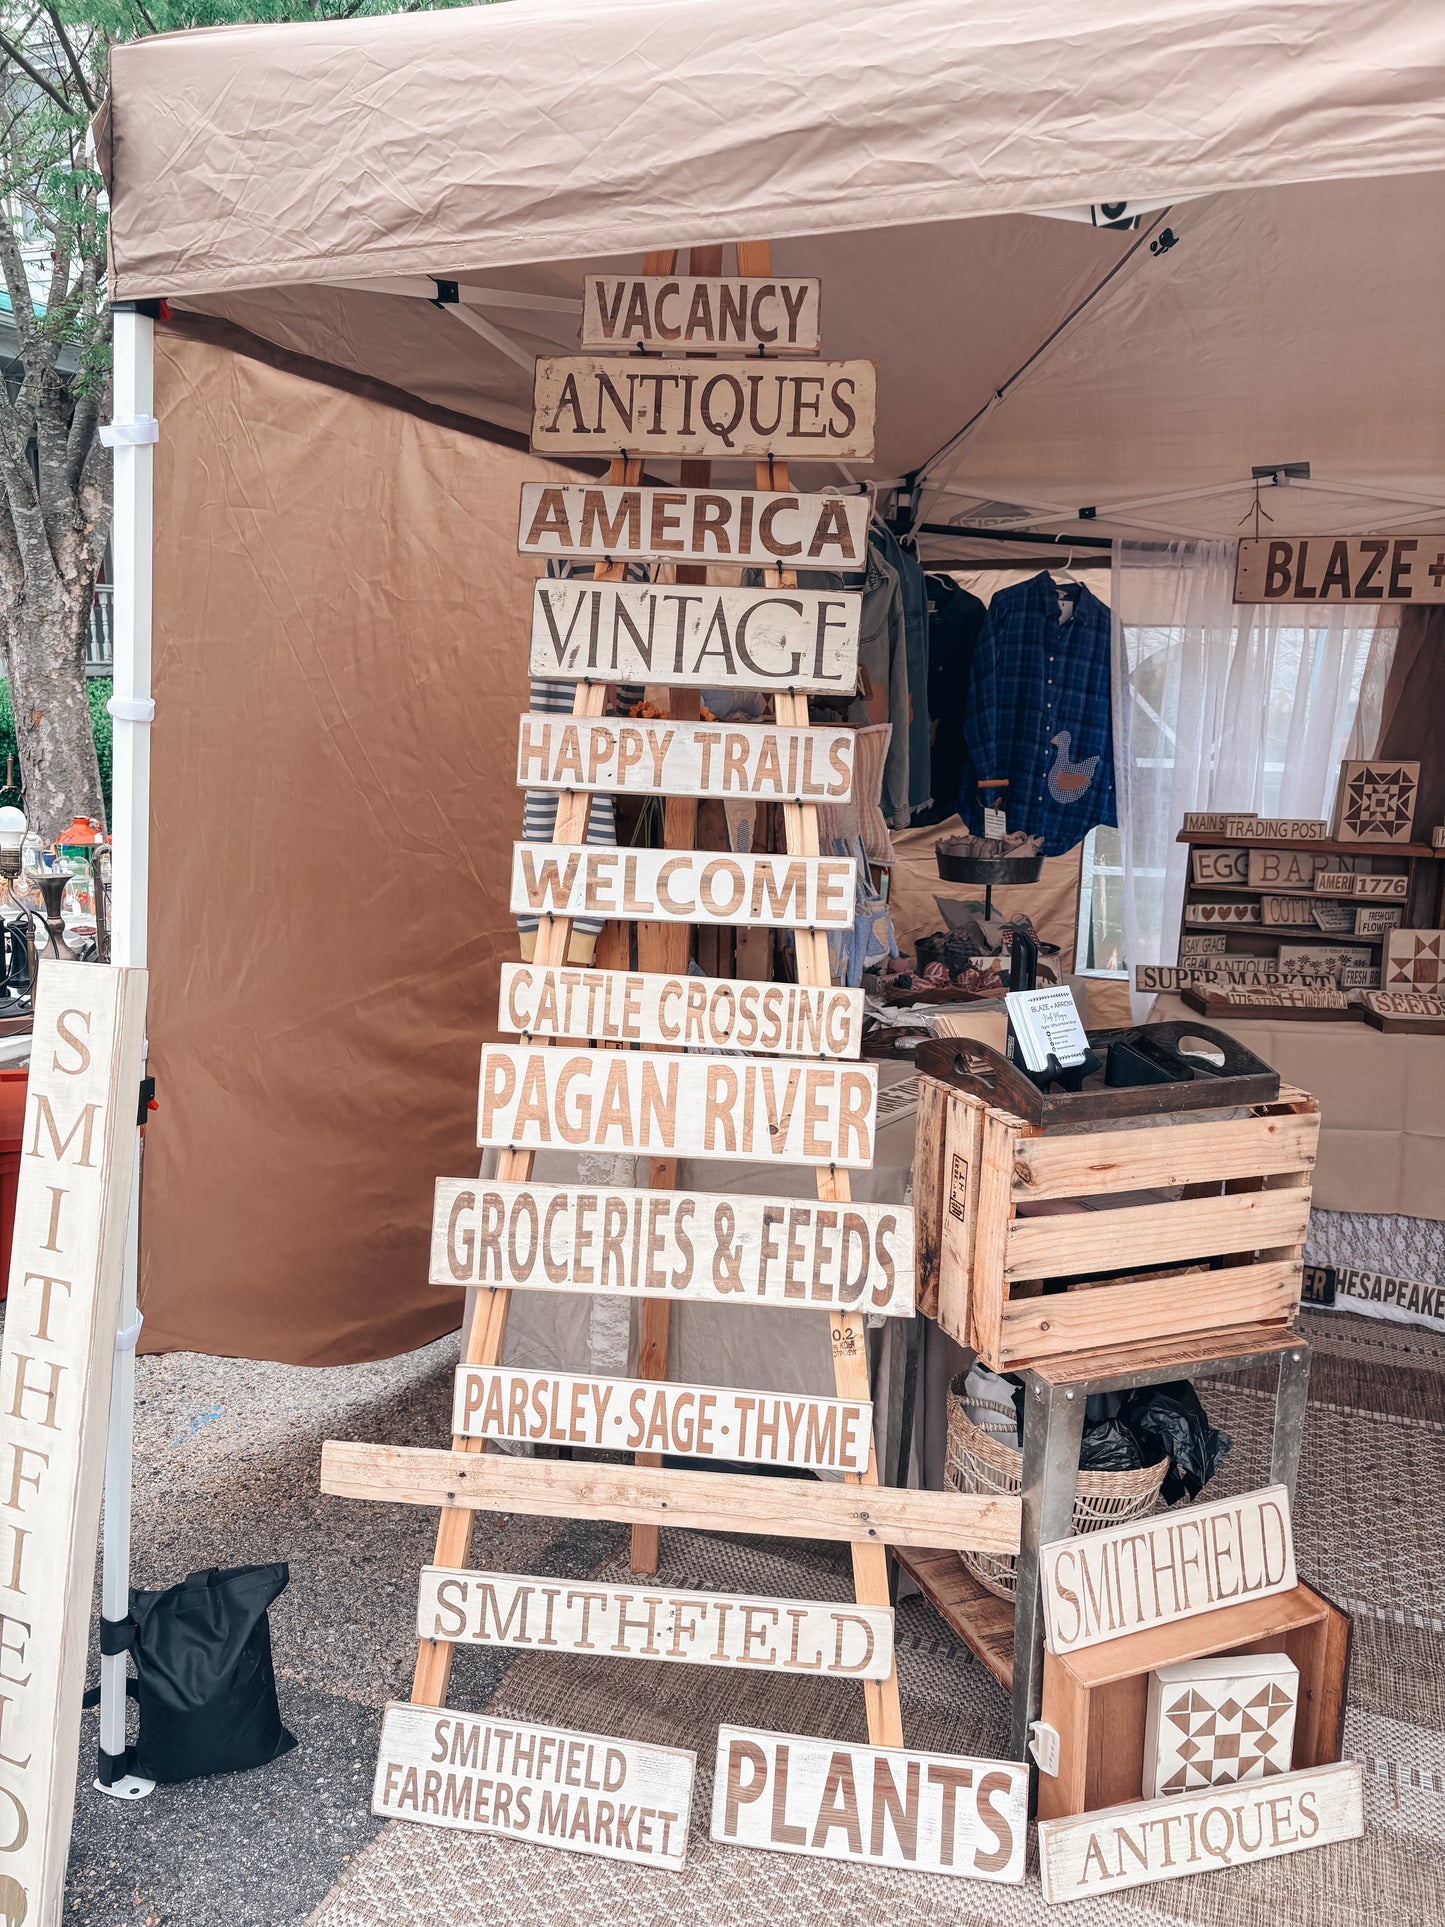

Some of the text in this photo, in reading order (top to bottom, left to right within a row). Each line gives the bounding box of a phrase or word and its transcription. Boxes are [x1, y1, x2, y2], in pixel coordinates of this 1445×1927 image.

[595, 281, 808, 343] VACANCY
[545, 373, 856, 448] ANTIQUES
[525, 489, 856, 559] AMERICA
[1264, 540, 1418, 598] BLAZE
[538, 589, 847, 681] VINTAGE
[519, 723, 852, 796] HAPPY TRAILS
[1189, 815, 1217, 830] MAIN
[1228, 820, 1288, 837] TRADING
[1291, 823, 1325, 839] POST
[520, 850, 850, 921] WELCOME
[1358, 878, 1406, 894] 1776
[1369, 911, 1395, 921] FRESH CUT
[1186, 937, 1225, 953] SAY GRACE
[1346, 970, 1367, 984] FRESH
[508, 969, 851, 1054] CATTLE CROSSING
[482, 1053, 873, 1160] PAGAN RIVER
[447, 1191, 897, 1308] GROCERIES & FEEDS
[1325, 1264, 1445, 1318] HESAPEAKE
[1056, 1500, 1287, 1645] SMITHFIELD
[433, 1579, 875, 1673] SMITHFIELD
[431, 1719, 627, 1793] SMITHFIELD
[382, 1763, 679, 1857] FARMERS MARKET
[723, 1740, 1012, 1873] PLANTS
[1077, 1791, 1320, 1885] ANTIQUES
